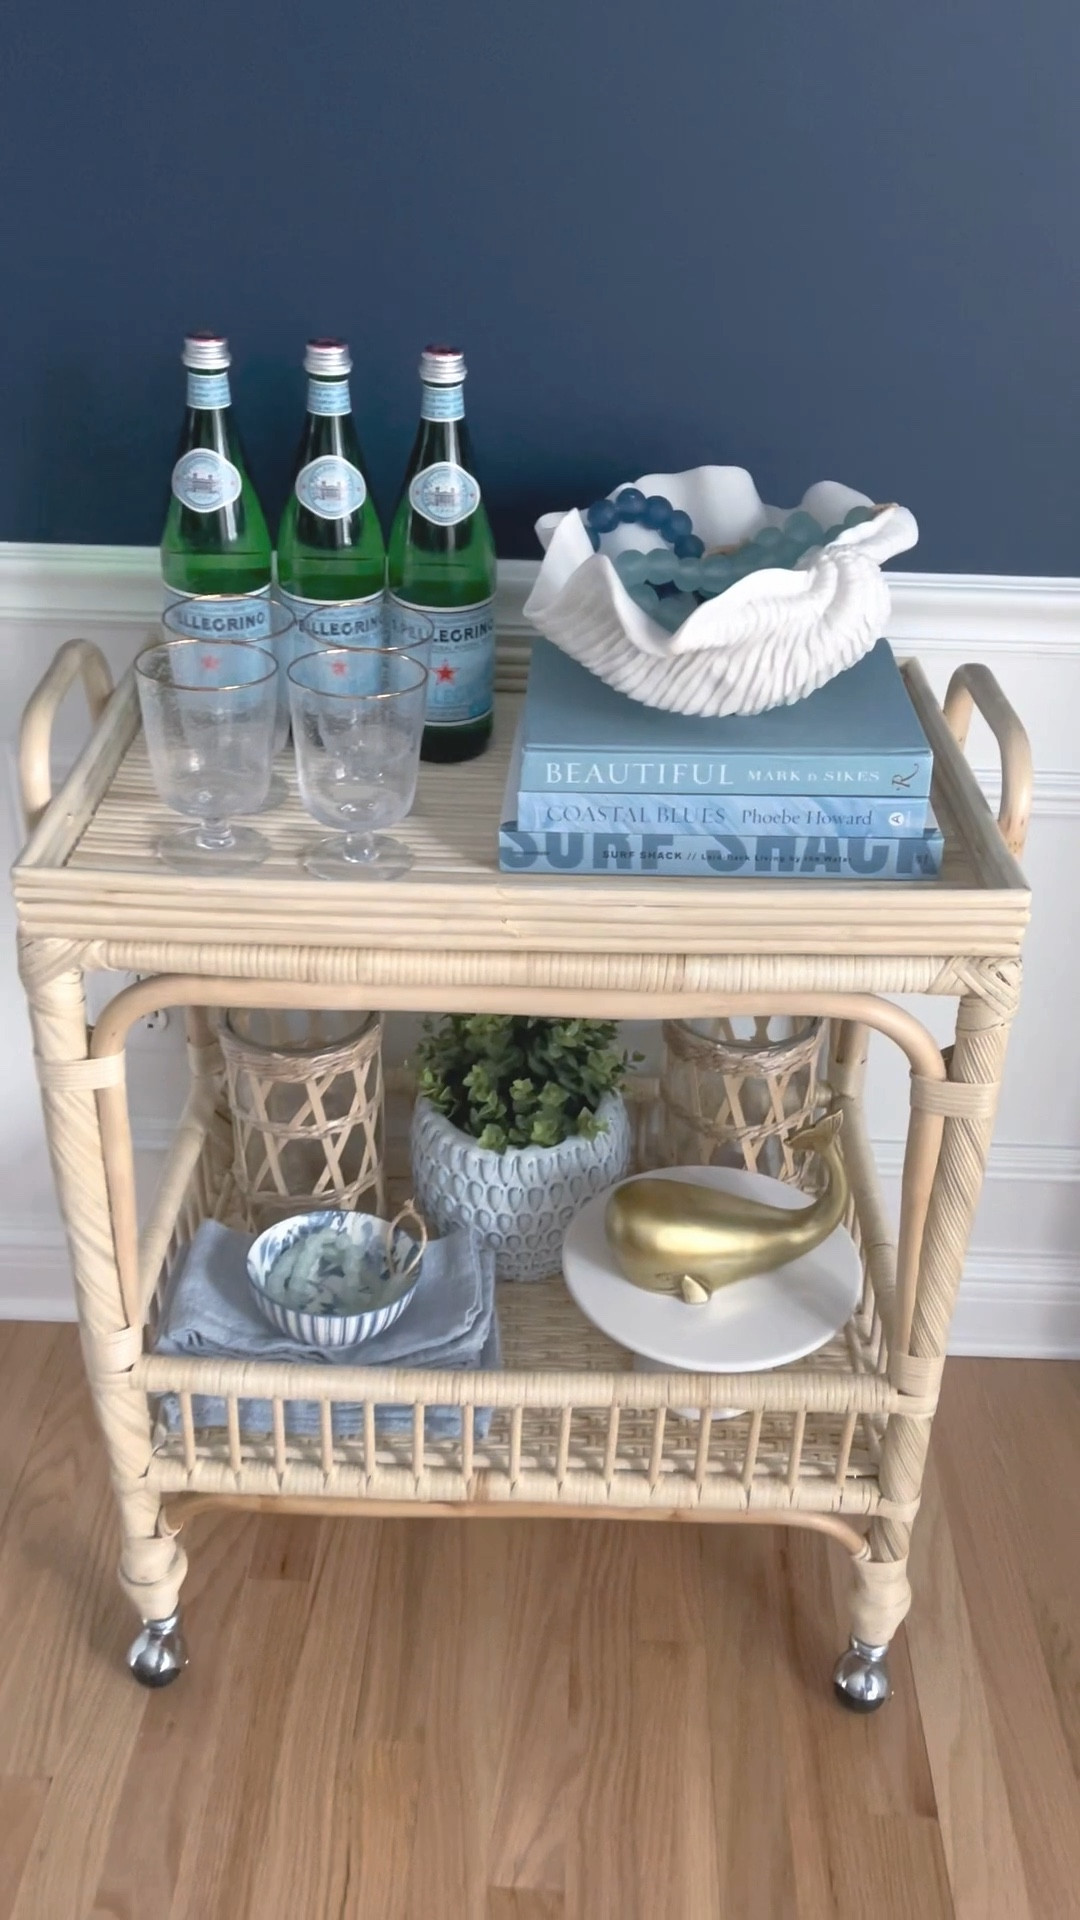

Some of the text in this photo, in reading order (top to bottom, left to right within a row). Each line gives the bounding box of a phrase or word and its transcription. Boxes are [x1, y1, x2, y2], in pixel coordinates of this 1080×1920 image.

[546, 762, 734, 785] BEAUTIFUL
[748, 770, 800, 782] MARK
[823, 771, 880, 782] SIKES
[546, 806, 873, 826] COASTAL BLUES Phoebe Howard
[500, 832, 938, 876] SURF SHACK
[602, 850, 636, 860] SURF
[639, 851, 683, 861] SHACK
